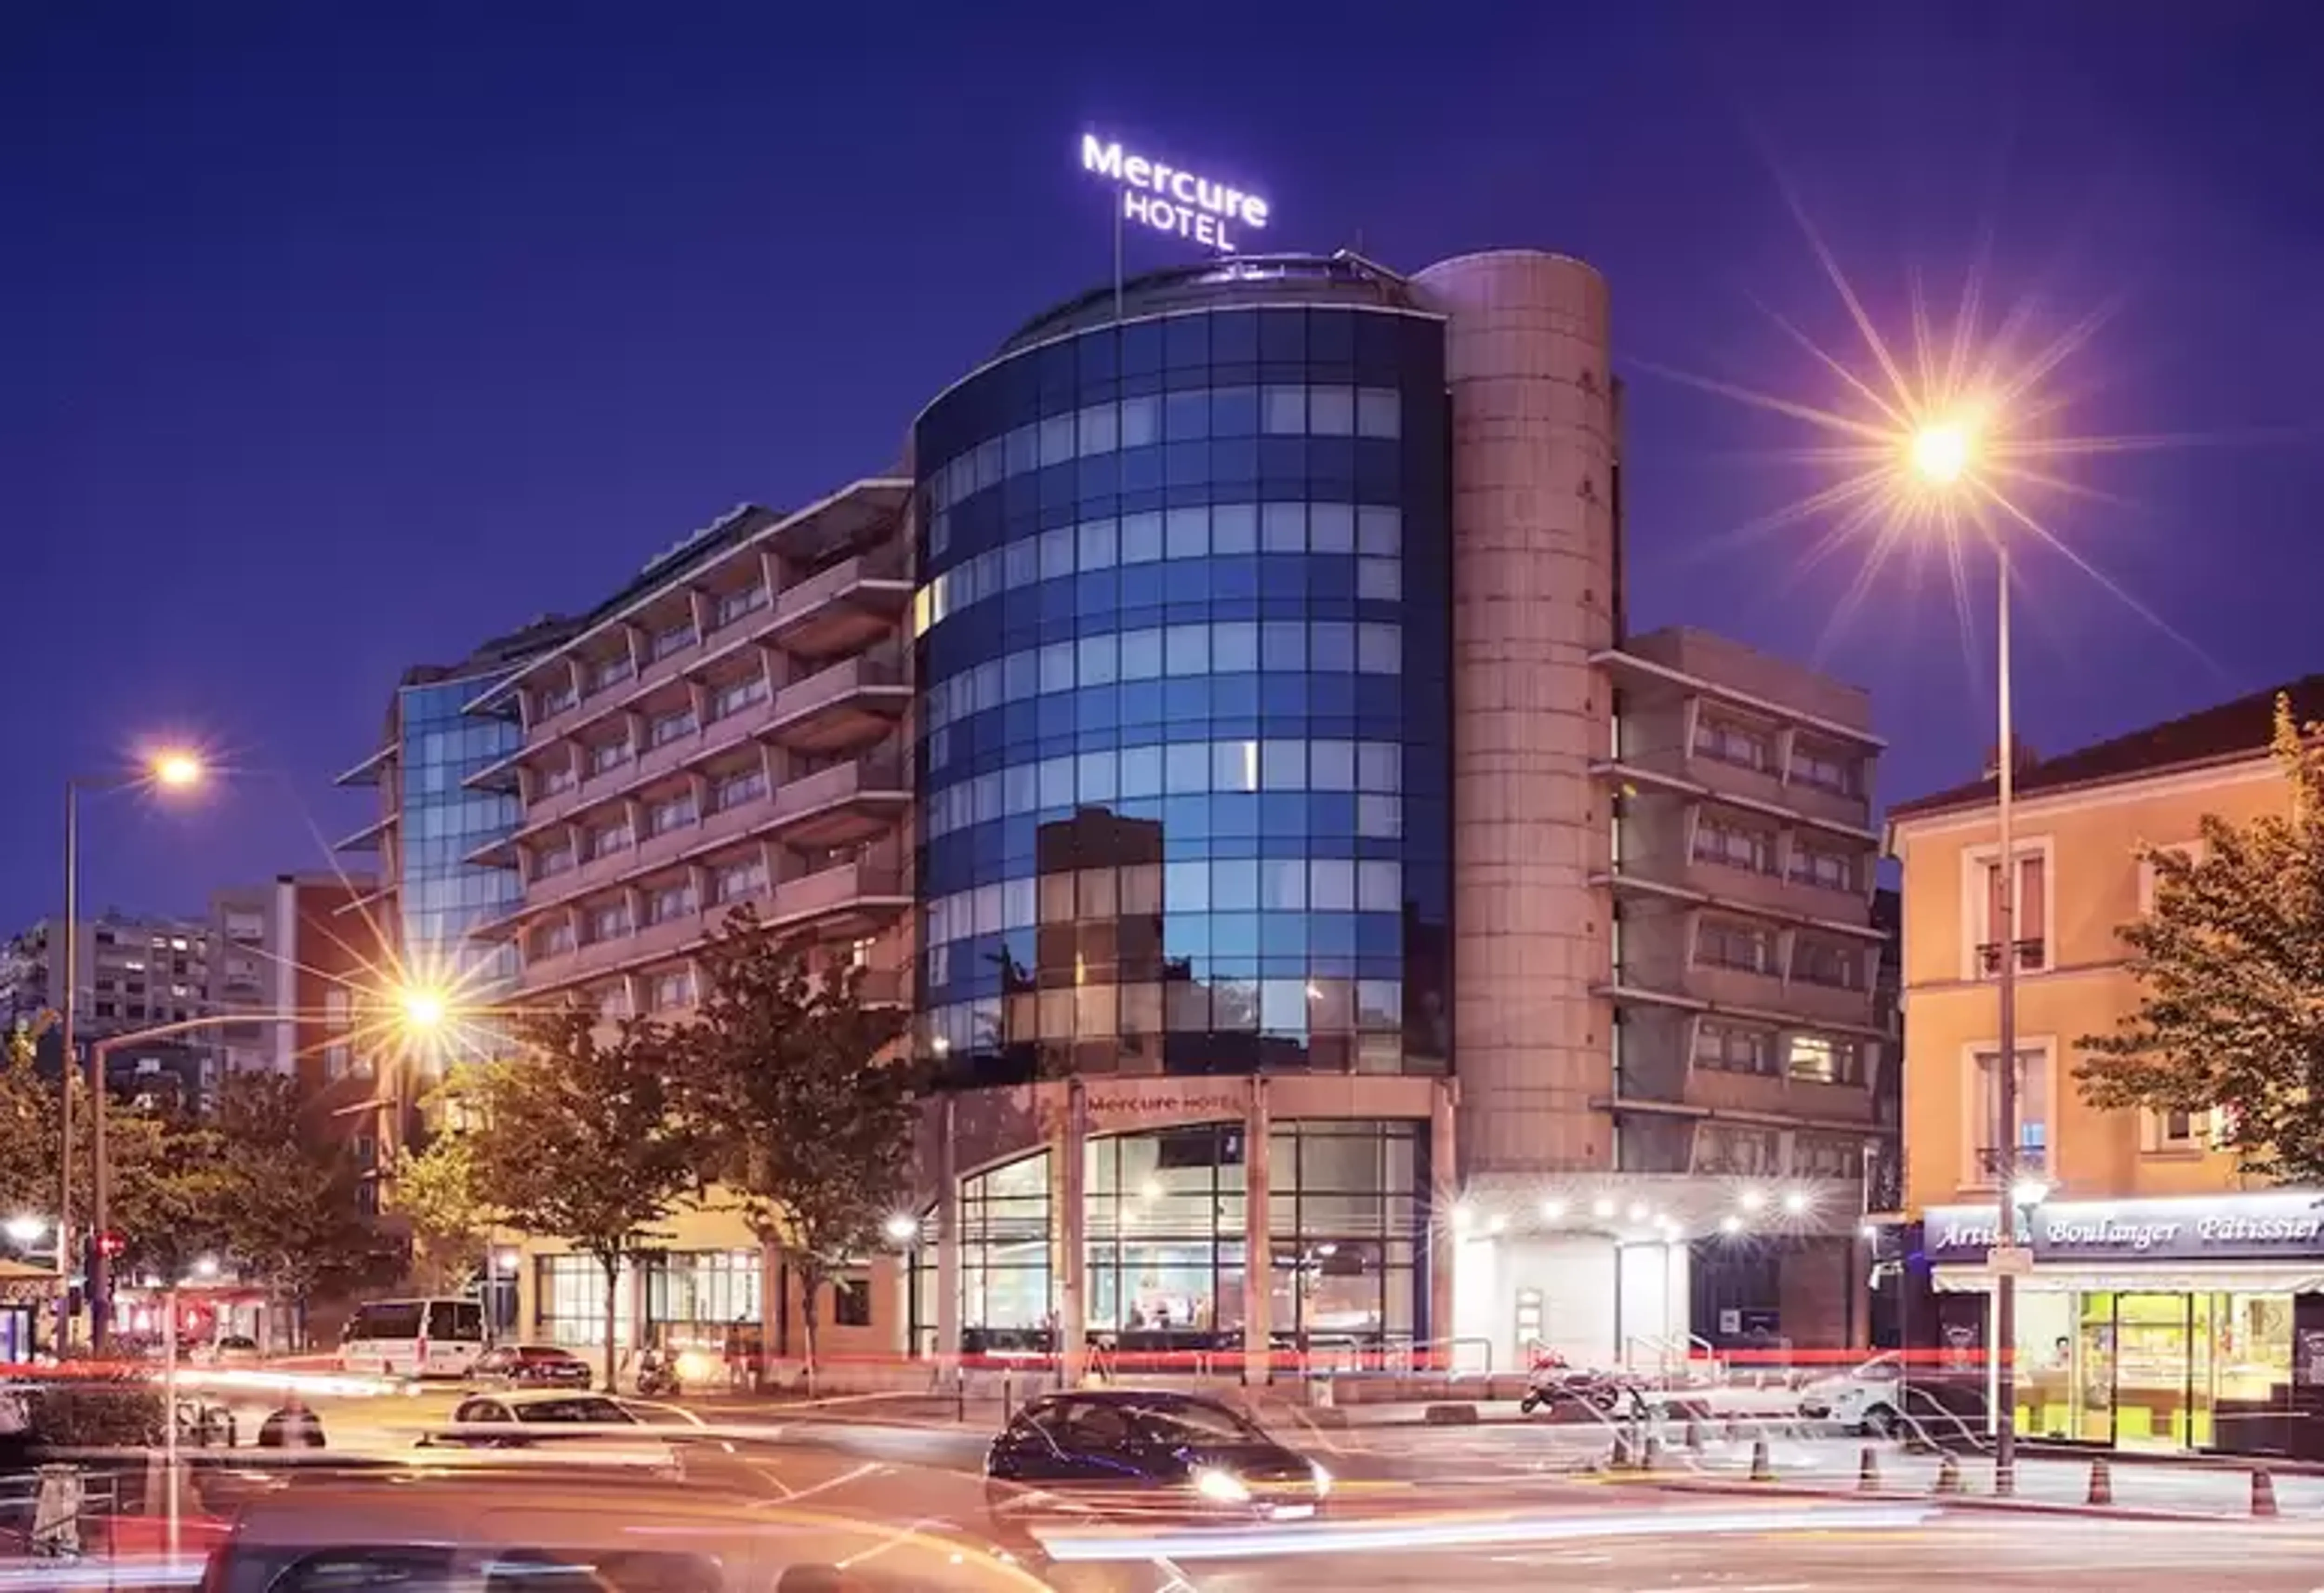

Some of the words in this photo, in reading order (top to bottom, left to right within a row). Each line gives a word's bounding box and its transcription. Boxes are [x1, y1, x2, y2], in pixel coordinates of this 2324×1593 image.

[1083, 133, 1268, 228] Mercure
[1125, 190, 1235, 251] HOTEL
[1088, 1096, 1178, 1112] Mercure
[1935, 1223, 2033, 1248] Artisn
[2047, 1214, 2182, 1250] Boulanger
